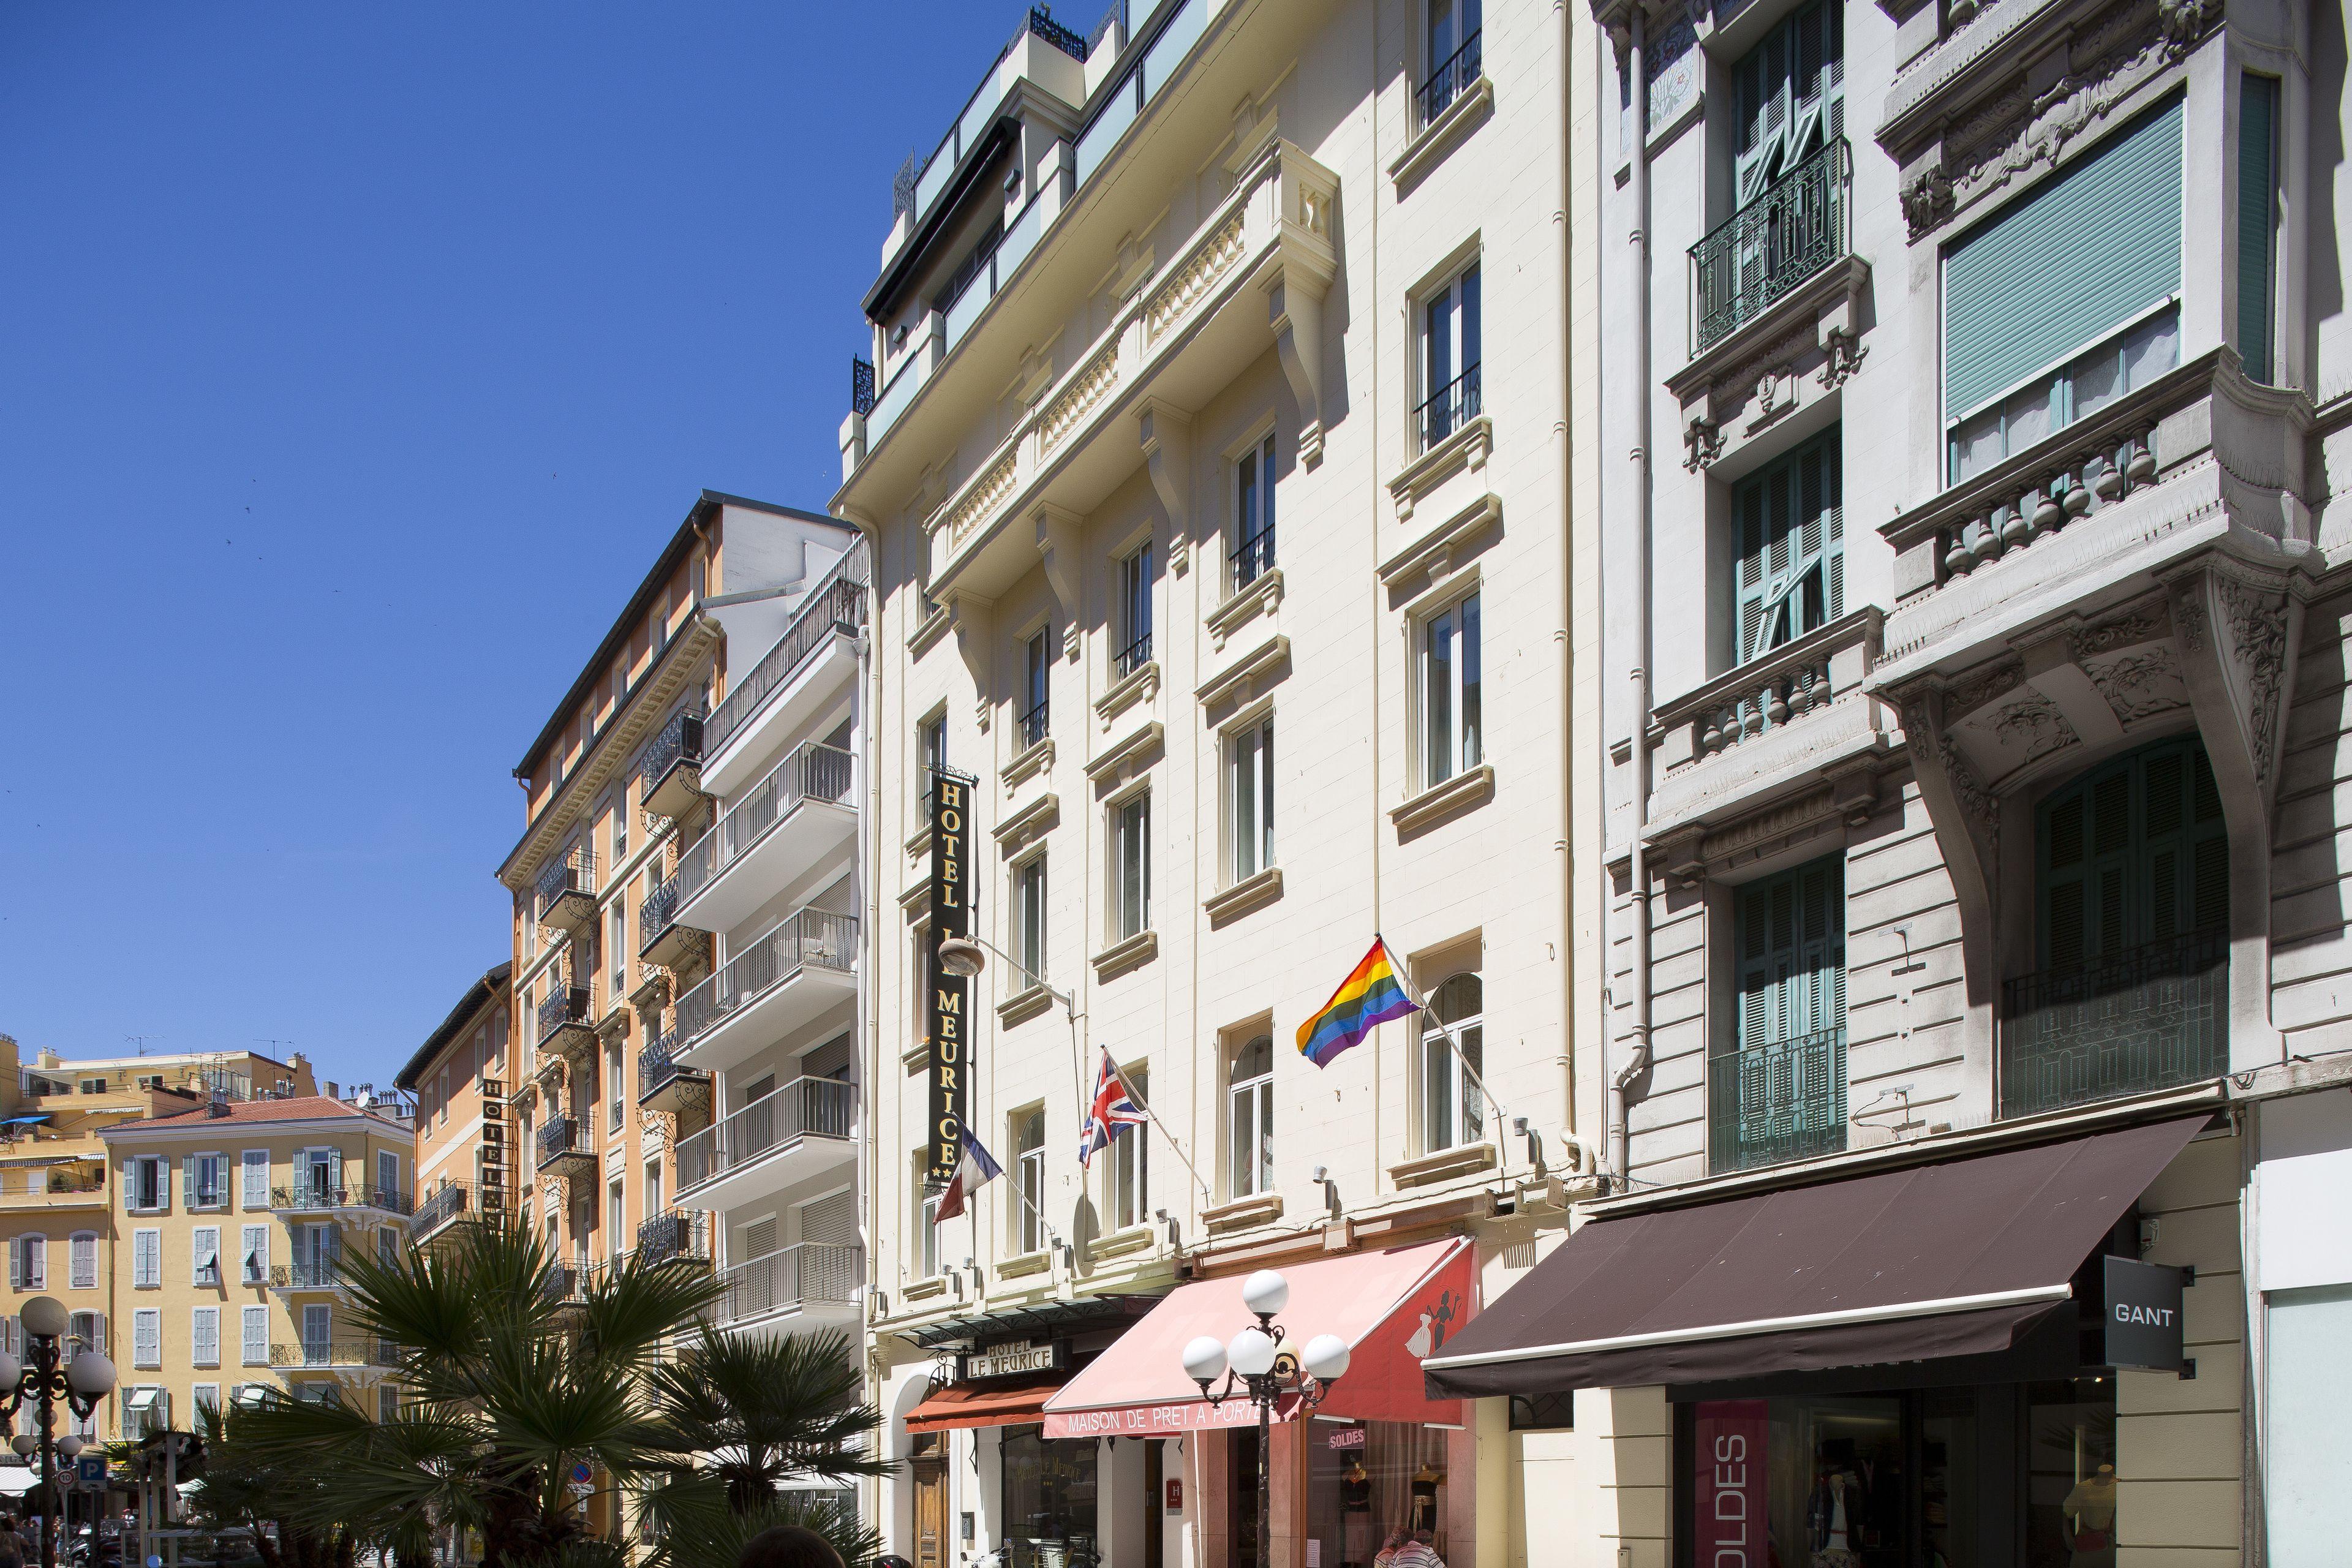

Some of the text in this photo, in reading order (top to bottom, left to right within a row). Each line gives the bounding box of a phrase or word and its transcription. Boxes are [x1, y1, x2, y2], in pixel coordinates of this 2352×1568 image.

[941, 782, 962, 908] HOTEL
[937, 989, 961, 1166] MEURICE
[486, 1082, 500, 1183] HOTEL
[2115, 1303, 2173, 1327] GANT
[988, 1340, 1030, 1358] HOTEL
[970, 1350, 1051, 1378] LE MEURICE
[1068, 1411, 1120, 1433] MAISON
[1126, 1409, 1146, 1428] DE
[1153, 1406, 1190, 1427] PRET
[1196, 1404, 1206, 1424] A
[1330, 1430, 1364, 1449] SOLDES
[87, 1463, 99, 1477] P
[1172, 1486, 1180, 1496] H
